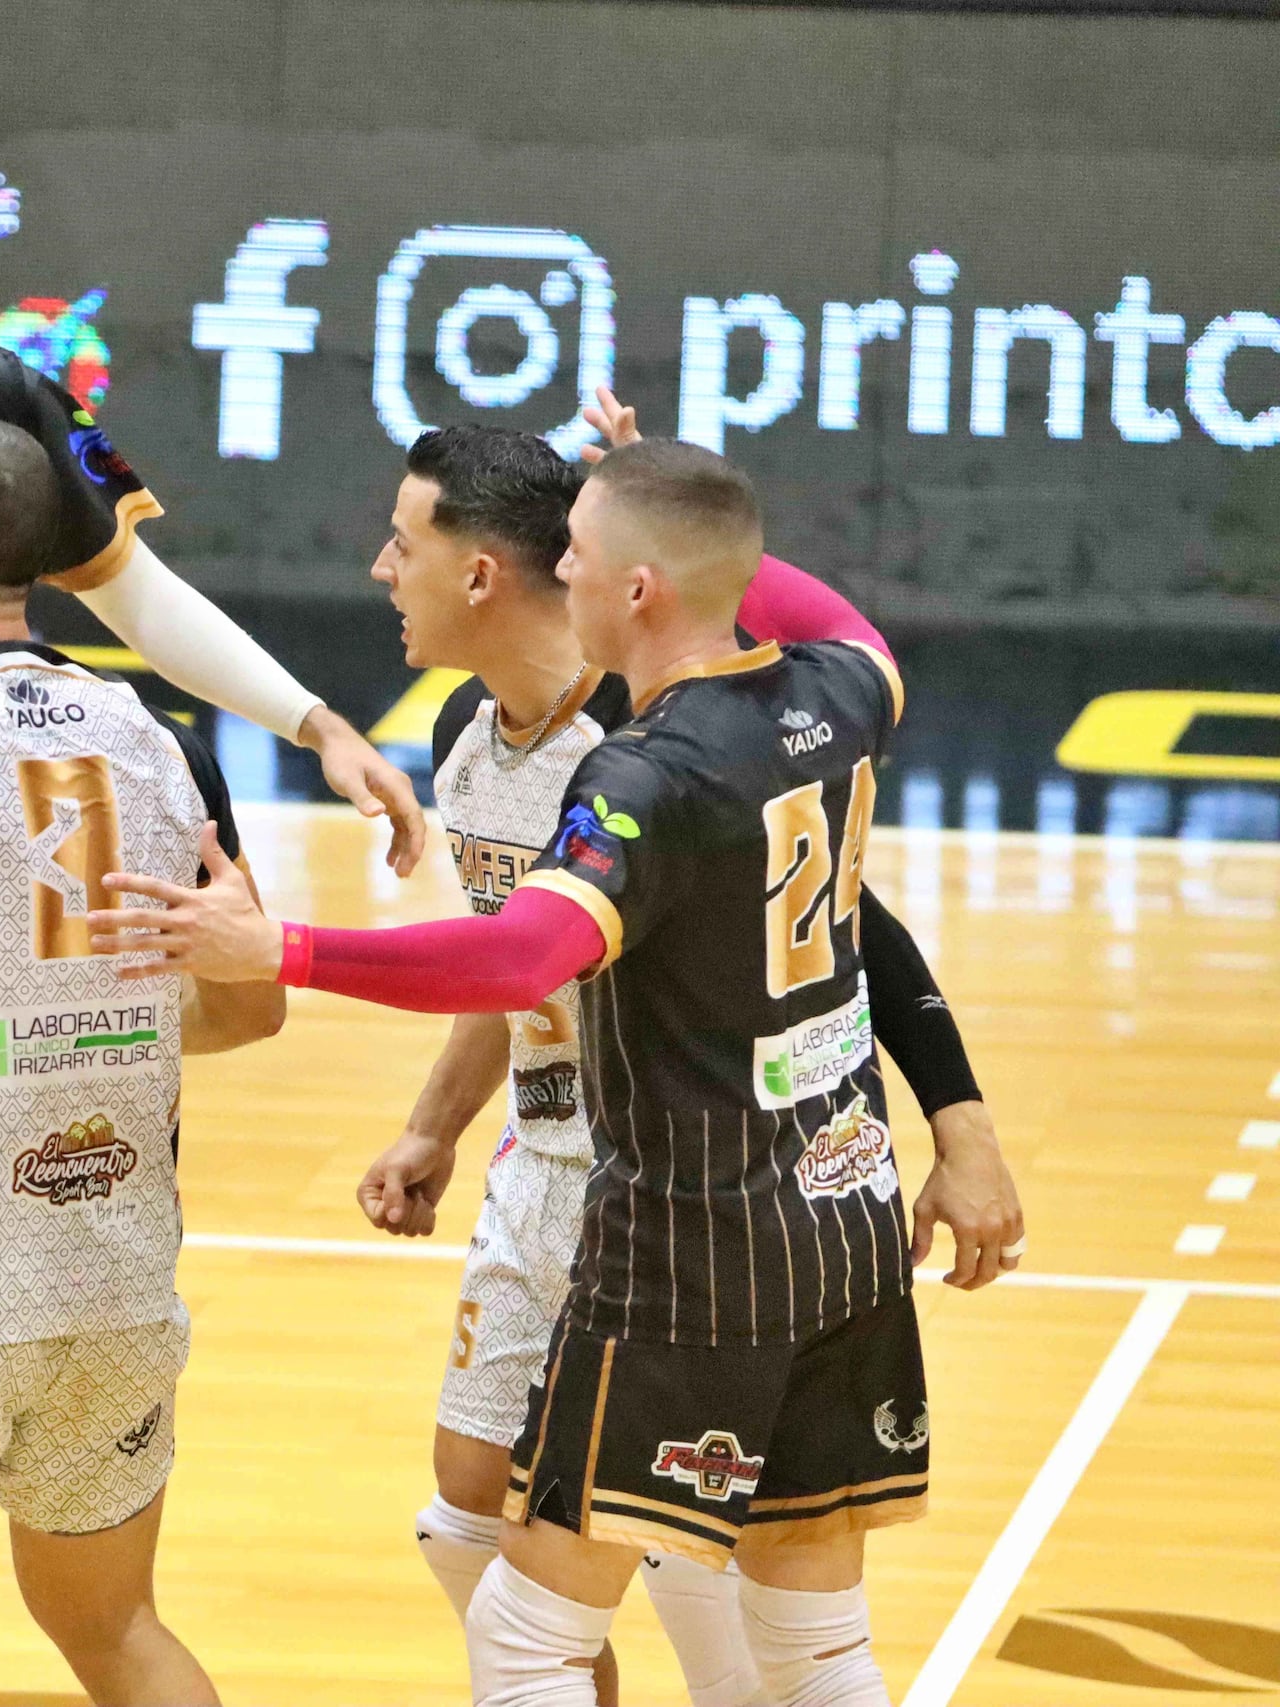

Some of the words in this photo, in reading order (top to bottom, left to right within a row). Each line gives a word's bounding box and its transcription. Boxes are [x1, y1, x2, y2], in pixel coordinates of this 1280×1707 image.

[17, 755, 124, 961] 3
[763, 755, 877, 999] 24
[12, 1037, 70, 1056] CLINICO
[13, 1050, 97, 1076] IRIZARRY
[43, 1135, 61, 1160] El
[14, 1142, 134, 1192] Reencuentro
[53, 1179, 84, 1202] Sport
[86, 1176, 110, 1198] Bar
